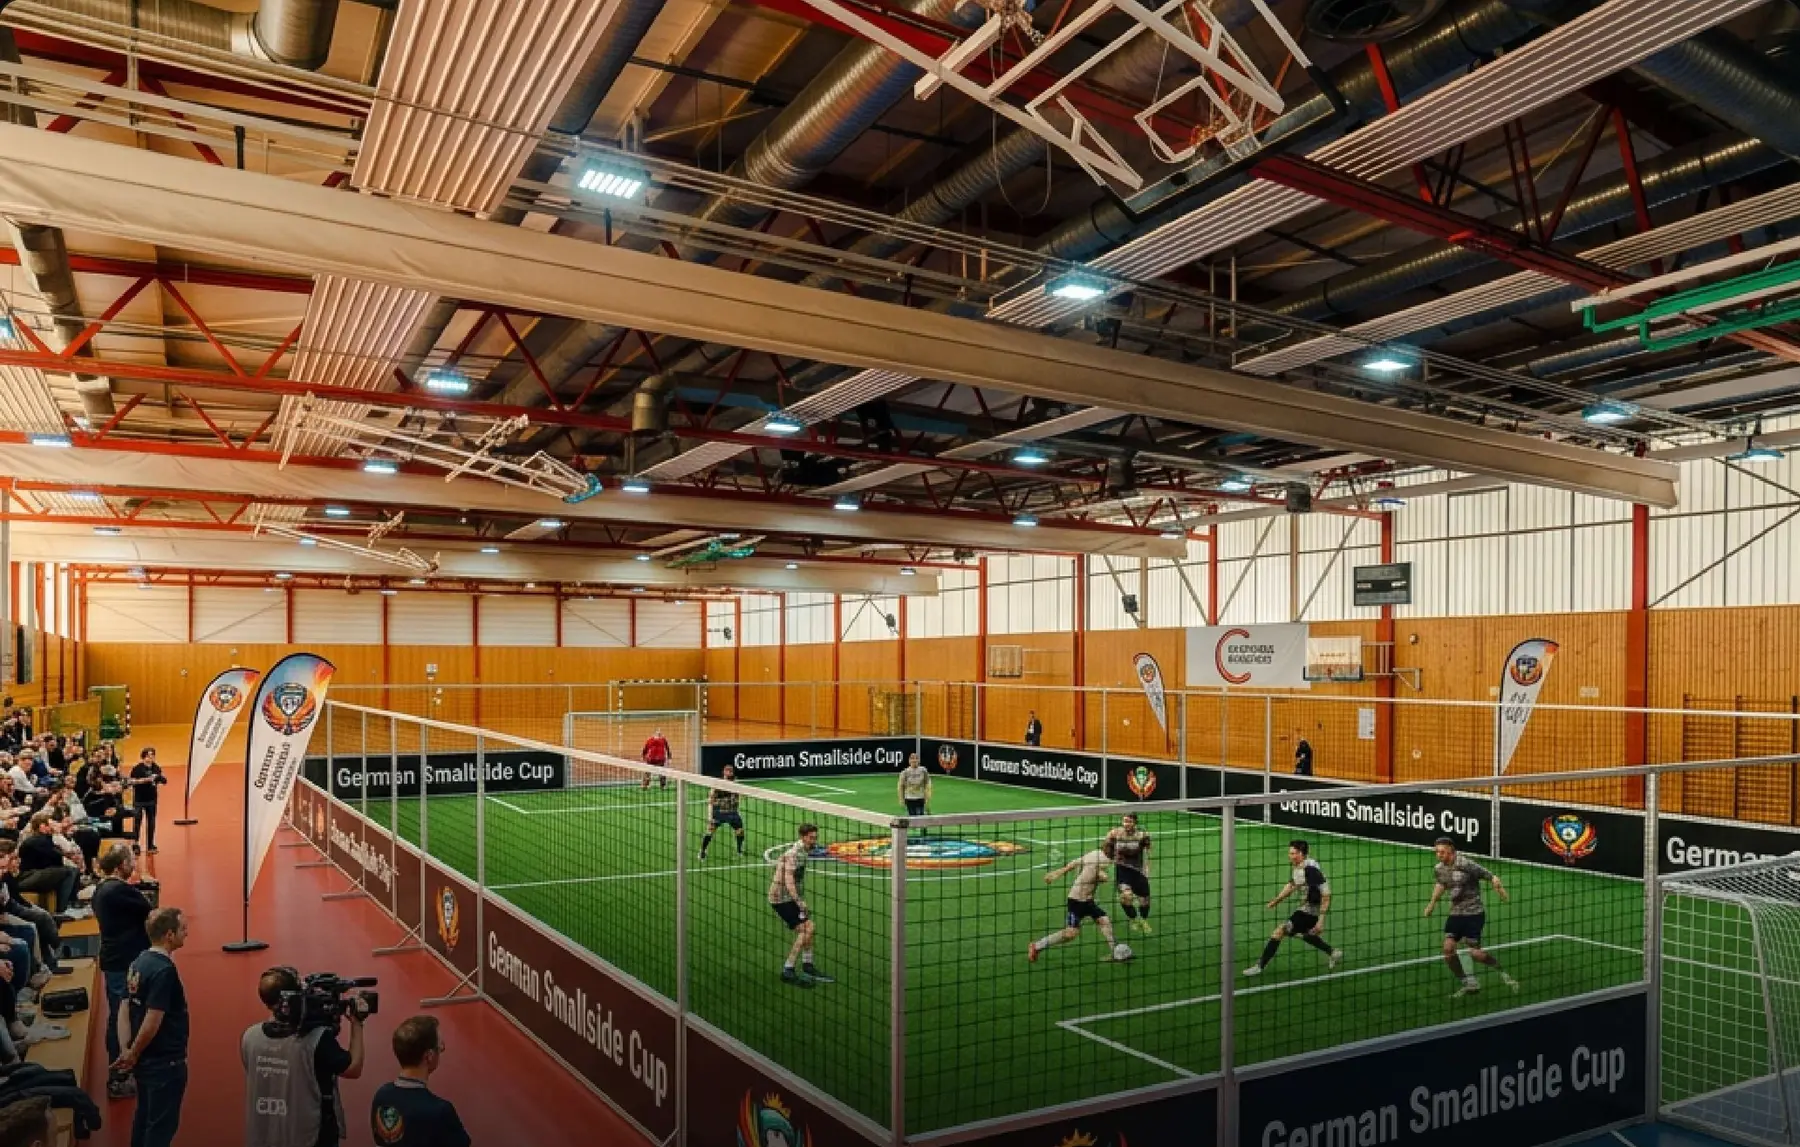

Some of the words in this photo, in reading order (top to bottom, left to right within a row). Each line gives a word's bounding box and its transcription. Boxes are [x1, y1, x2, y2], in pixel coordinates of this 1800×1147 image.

[424, 762, 514, 784] Smallide
[519, 762, 555, 784] Cup
[734, 752, 796, 769] German
[799, 748, 872, 767] Smallside
[875, 747, 904, 767] Cup
[1346, 798, 1436, 831] Smallside
[1440, 810, 1480, 842] Cup
[488, 930, 540, 1003] German
[544, 970, 624, 1067] Smallside
[630, 1029, 668, 1108] Cup
[1409, 1053, 1562, 1133] Smallside
[1570, 1045, 1625, 1093] Cup
